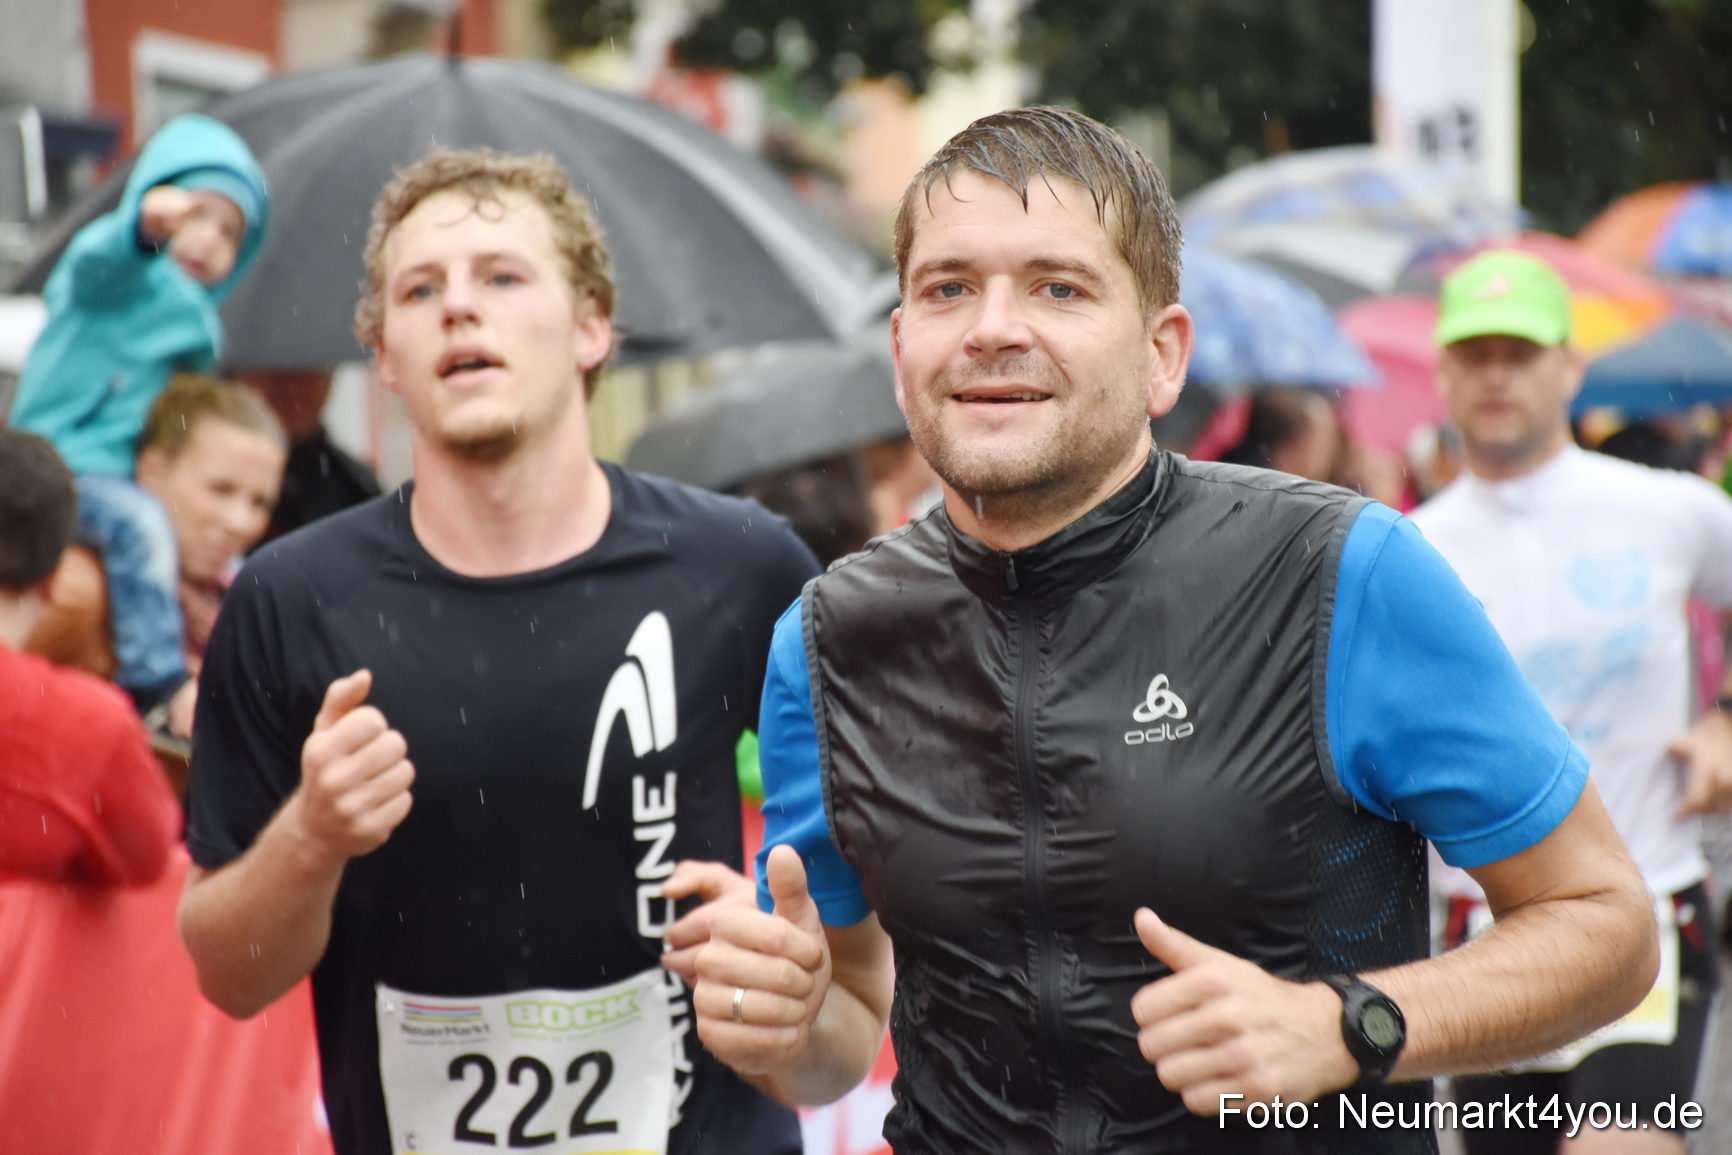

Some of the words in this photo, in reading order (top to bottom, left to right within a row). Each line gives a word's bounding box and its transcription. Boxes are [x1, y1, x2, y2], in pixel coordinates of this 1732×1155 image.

[1124, 721, 1194, 745] odlo
[505, 988, 641, 1031] BOCK
[447, 1049, 619, 1149] 222
